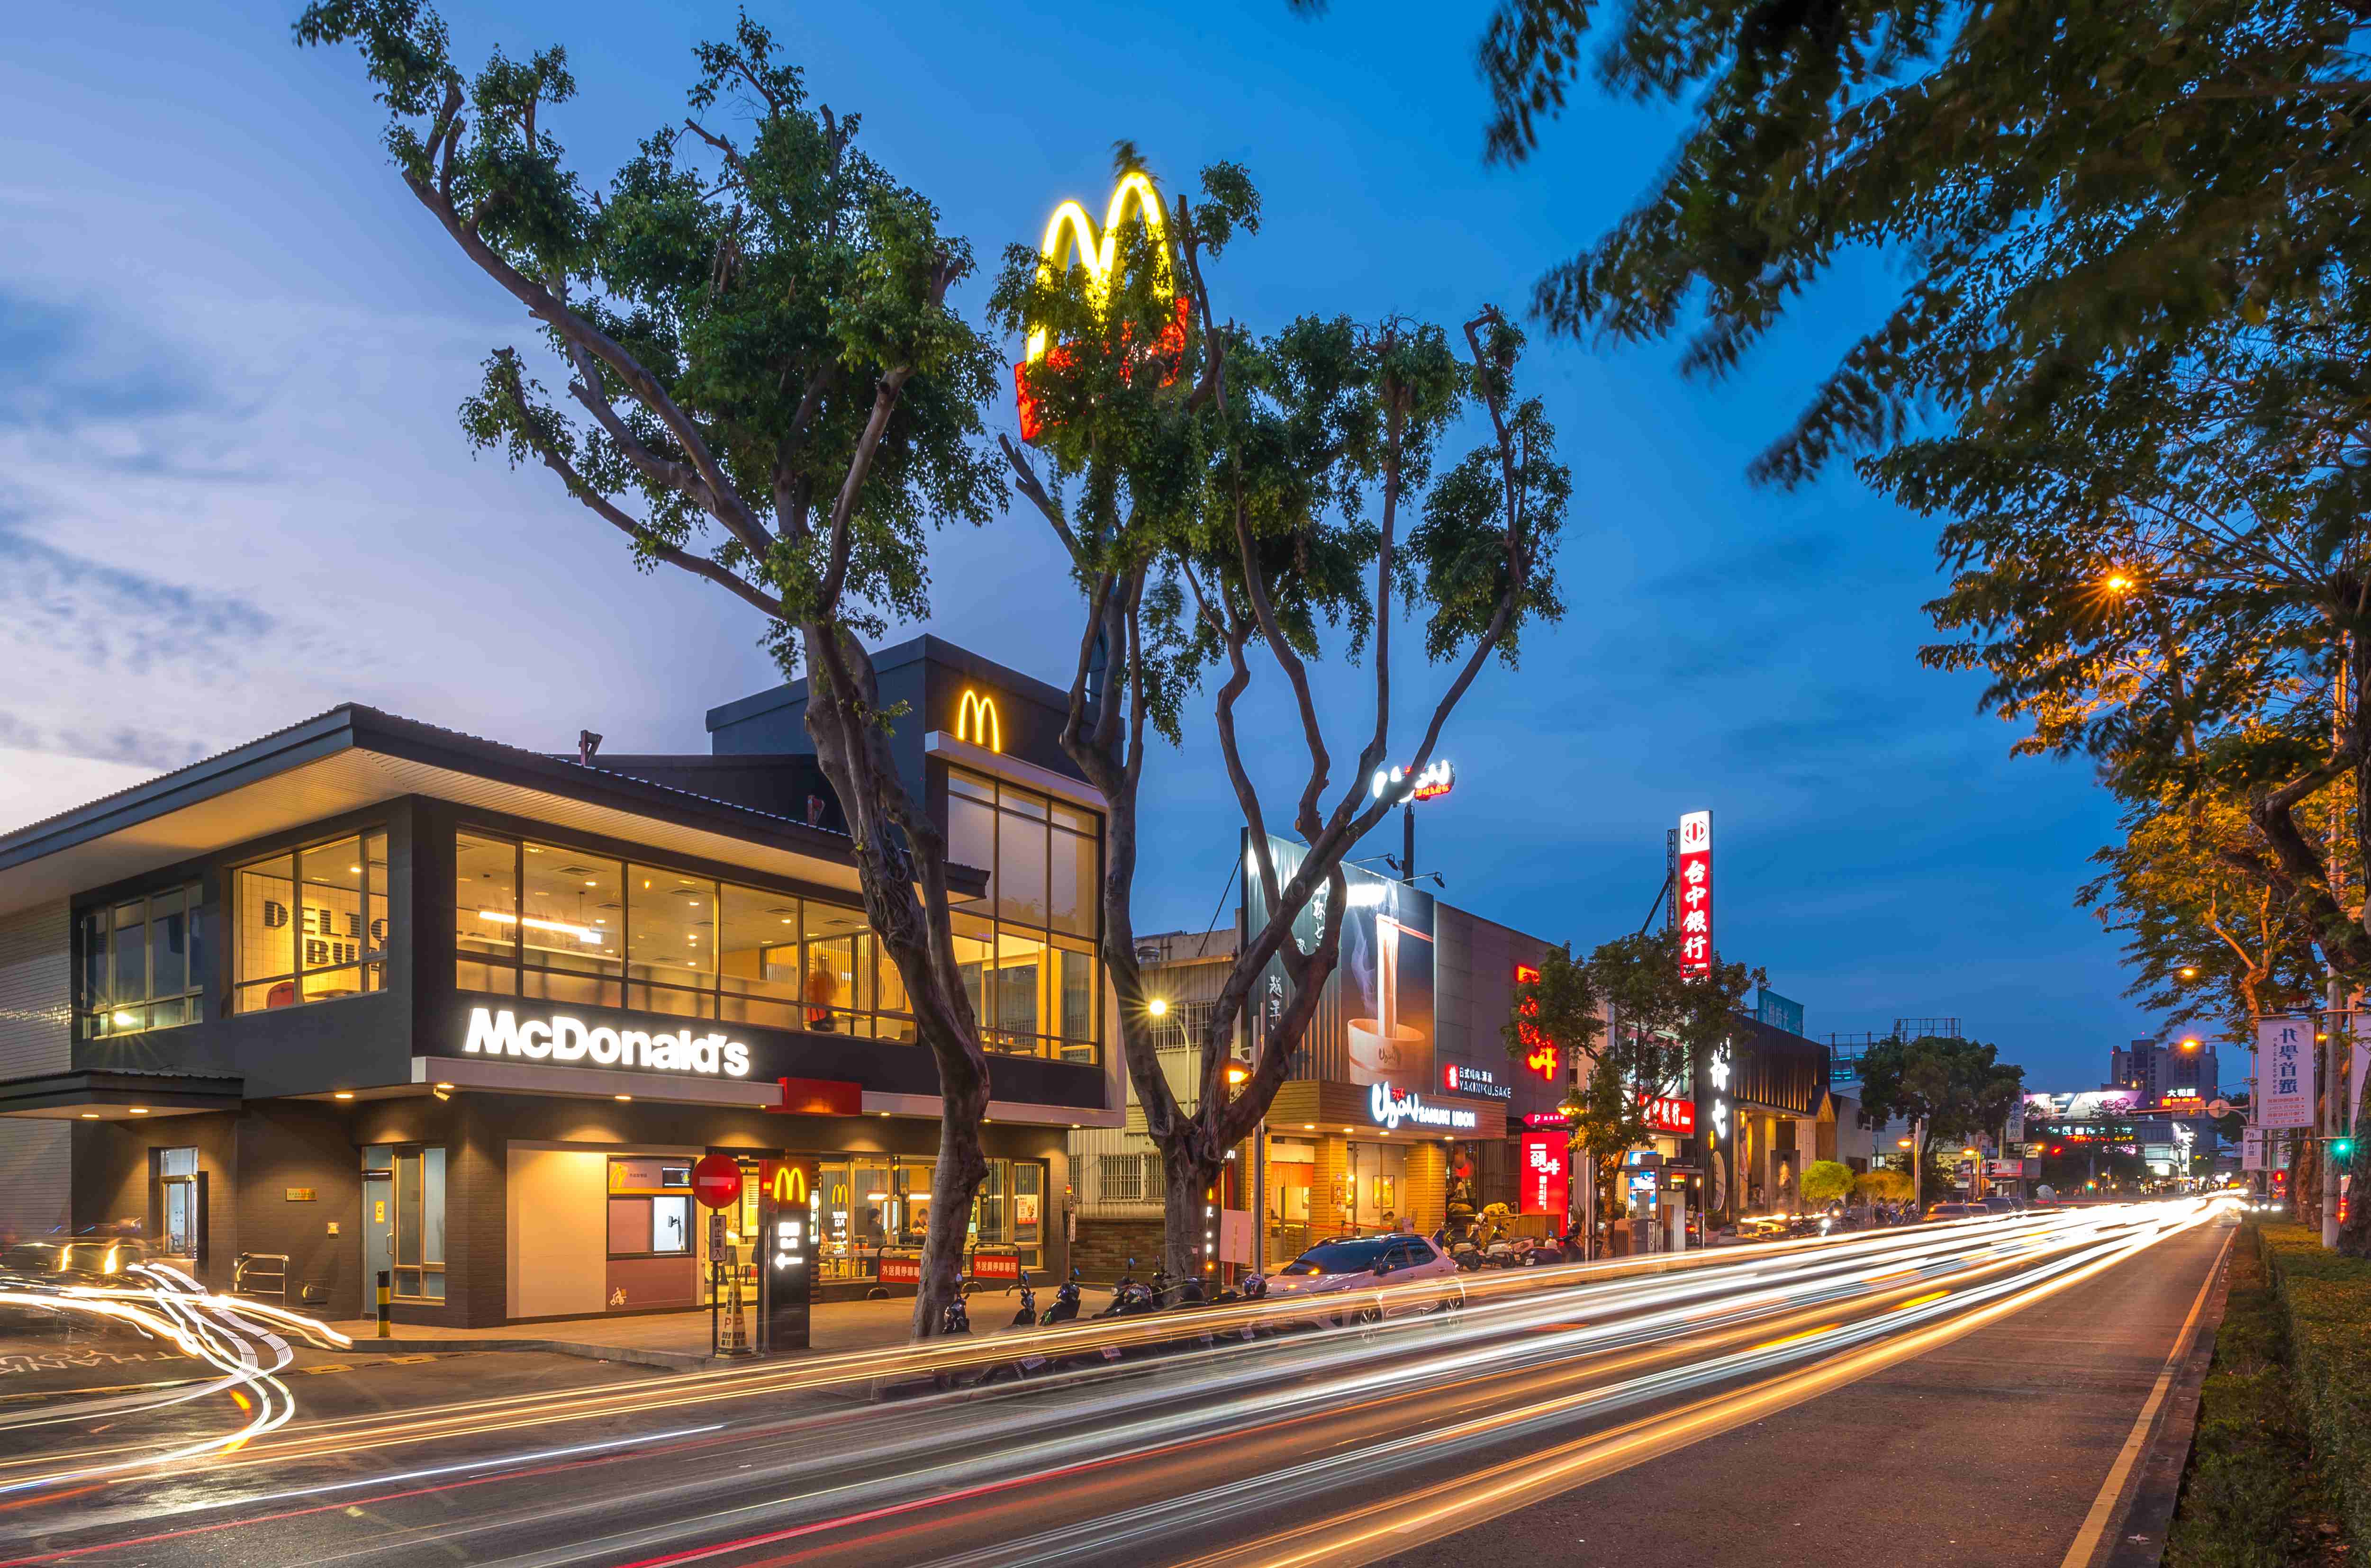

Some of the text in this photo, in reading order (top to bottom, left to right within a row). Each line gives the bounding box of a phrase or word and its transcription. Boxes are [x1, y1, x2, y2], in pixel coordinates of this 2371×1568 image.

[1683, 860, 1707, 959] 台中銀行
[463, 1008, 750, 1076] McDonald's
[1534, 1115, 1540, 1123] P
[714, 1218, 722, 1258] 禁止進入
[882, 1265, 920, 1278] 外送員停車專
[976, 1261, 1016, 1272] 外送員停車專用
